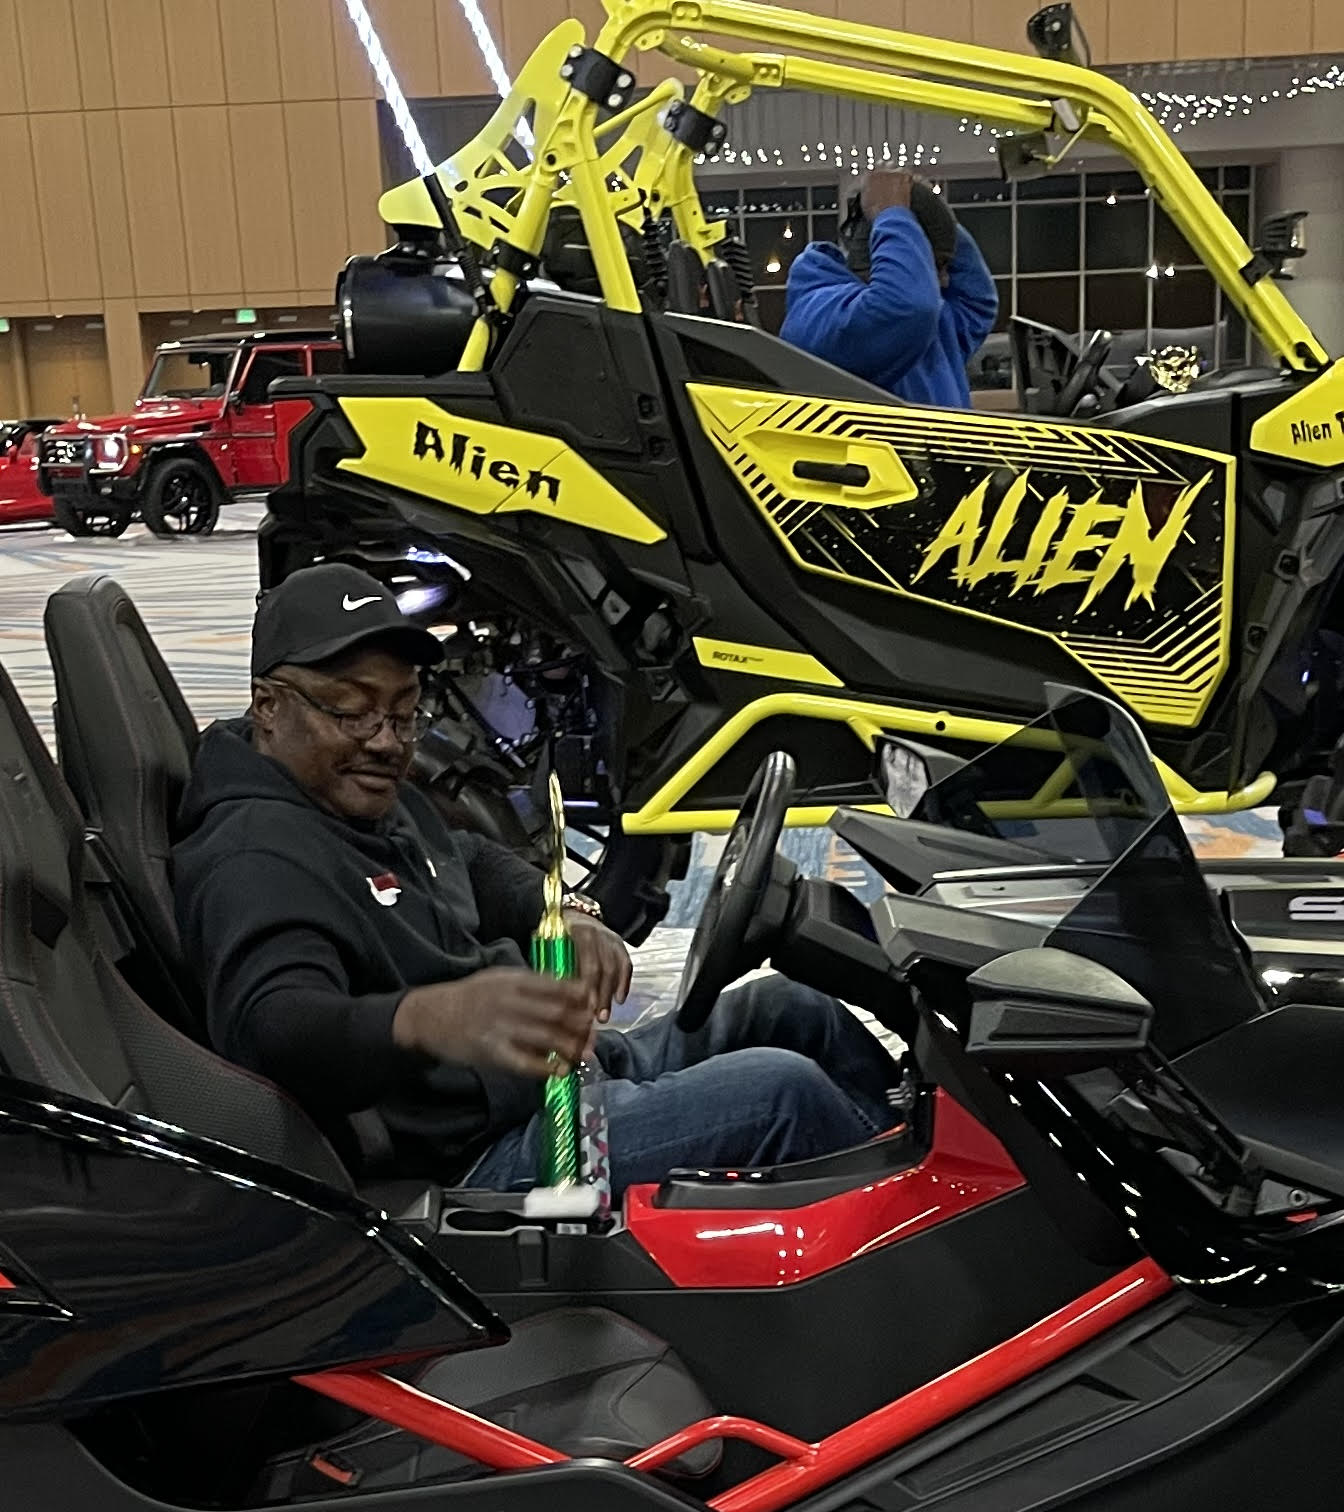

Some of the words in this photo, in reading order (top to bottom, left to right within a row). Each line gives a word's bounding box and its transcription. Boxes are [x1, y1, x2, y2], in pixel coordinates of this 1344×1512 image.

[413, 420, 561, 506] Alien
[1290, 420, 1332, 445] Alien
[910, 465, 1214, 616] ALIEN
